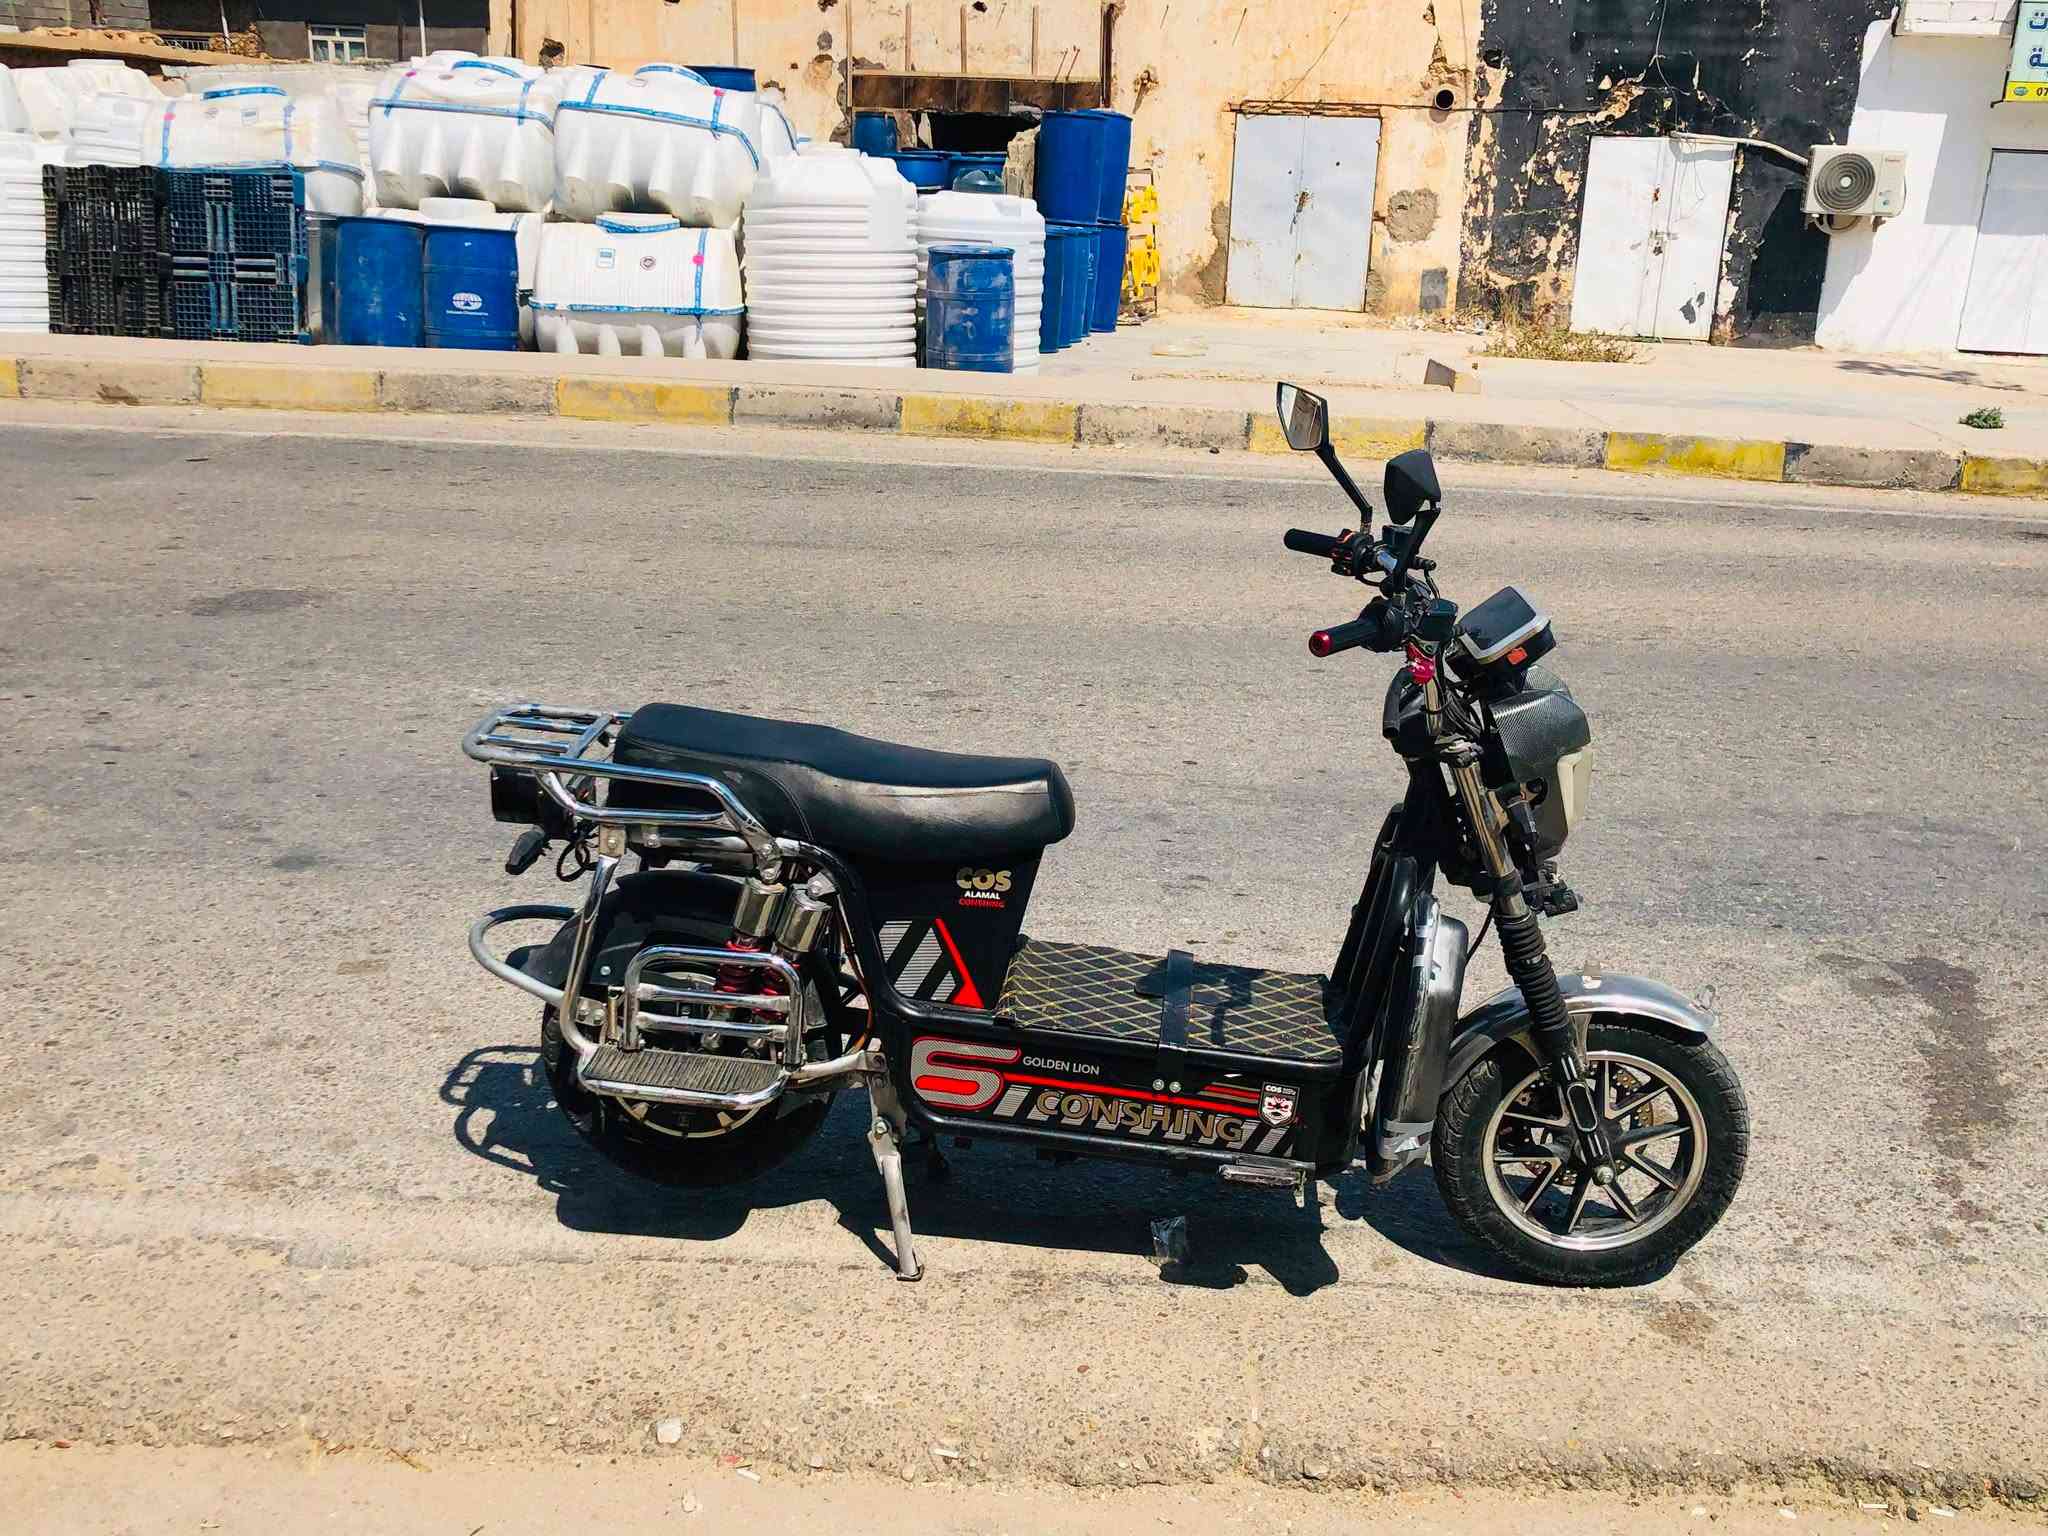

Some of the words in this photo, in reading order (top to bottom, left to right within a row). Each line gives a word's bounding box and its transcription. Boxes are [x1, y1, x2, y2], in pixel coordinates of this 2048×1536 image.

[956, 867, 1012, 892] COS
[964, 890, 1001, 900] ALAMAL
[1023, 1056, 1070, 1072] GOLDEN
[1072, 1063, 1100, 1076] LION
[1036, 1090, 1243, 1143] CONSHING
